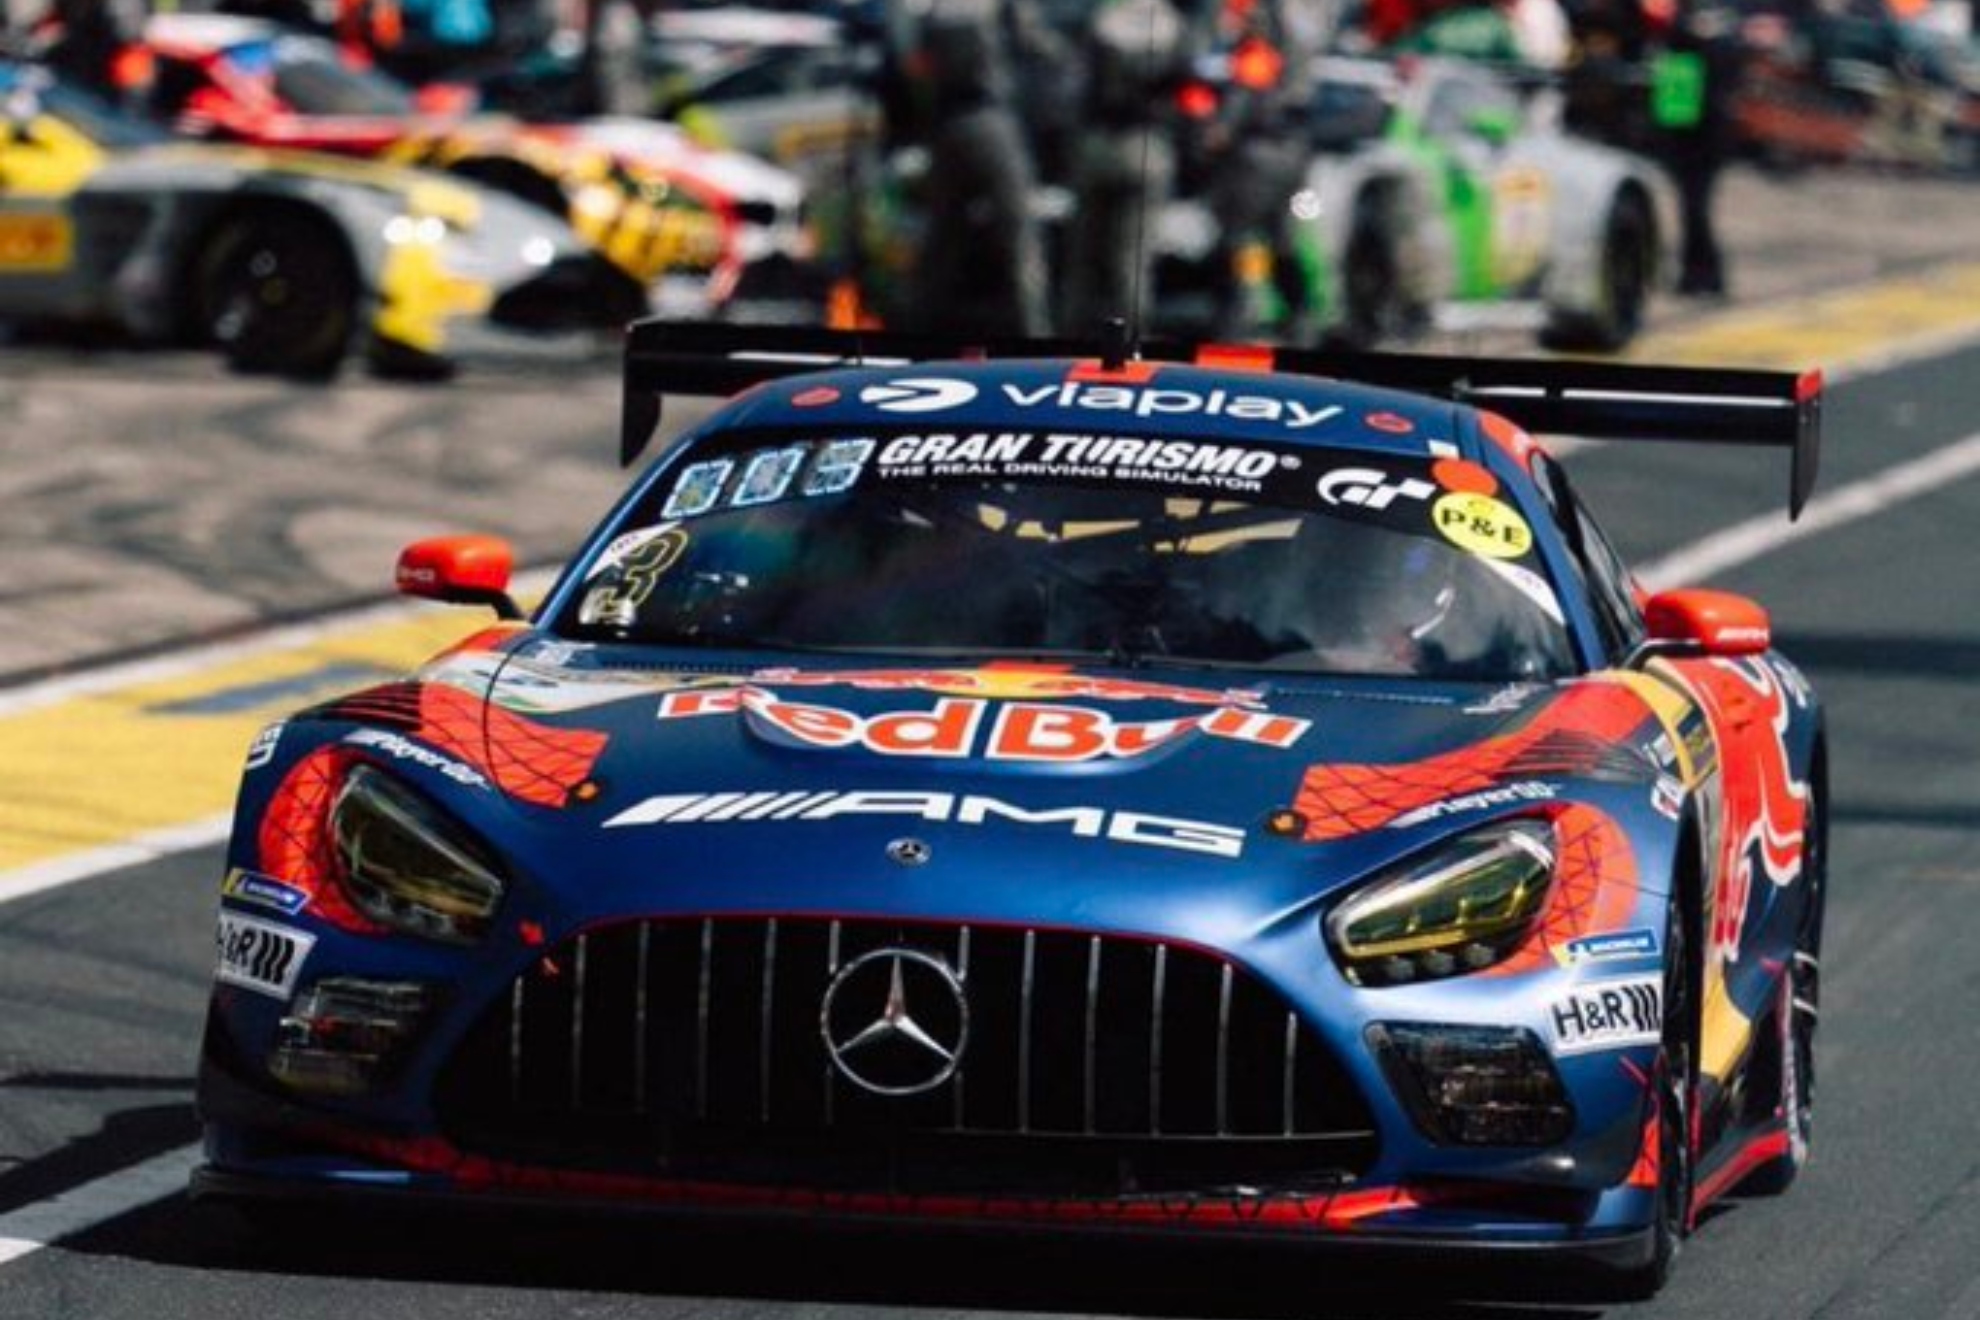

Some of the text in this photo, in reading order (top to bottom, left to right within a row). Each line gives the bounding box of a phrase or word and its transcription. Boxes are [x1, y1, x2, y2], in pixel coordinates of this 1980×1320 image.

[1001, 381, 1343, 427] viaplay
[878, 434, 1032, 465] GRAN
[877, 462, 1262, 492] THE REAL DRIVING SIMULATOR
